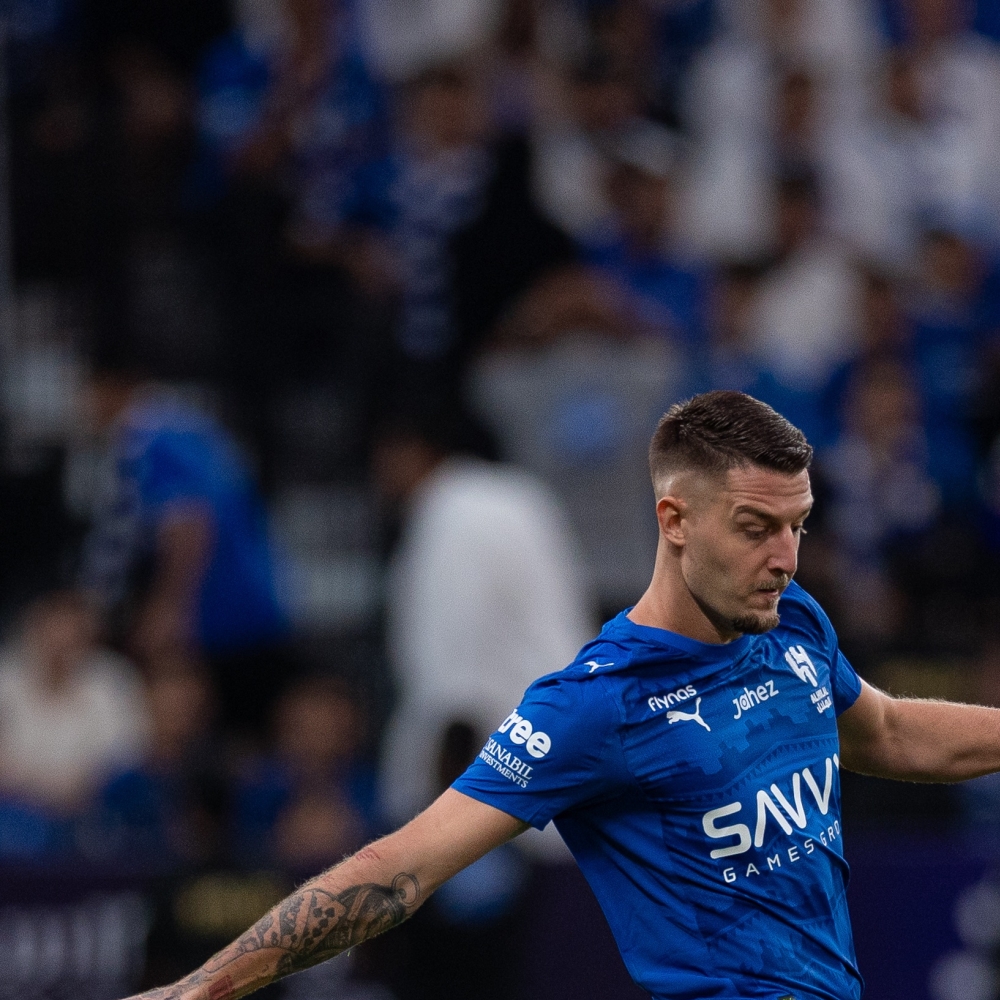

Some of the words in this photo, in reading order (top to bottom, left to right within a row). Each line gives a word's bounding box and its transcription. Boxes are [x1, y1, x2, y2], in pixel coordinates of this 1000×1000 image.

[647, 684, 698, 712] flynas
[732, 679, 780, 720] jahez
[483, 737, 534, 780] SANABIL
[722, 838, 815, 884] GAMES
